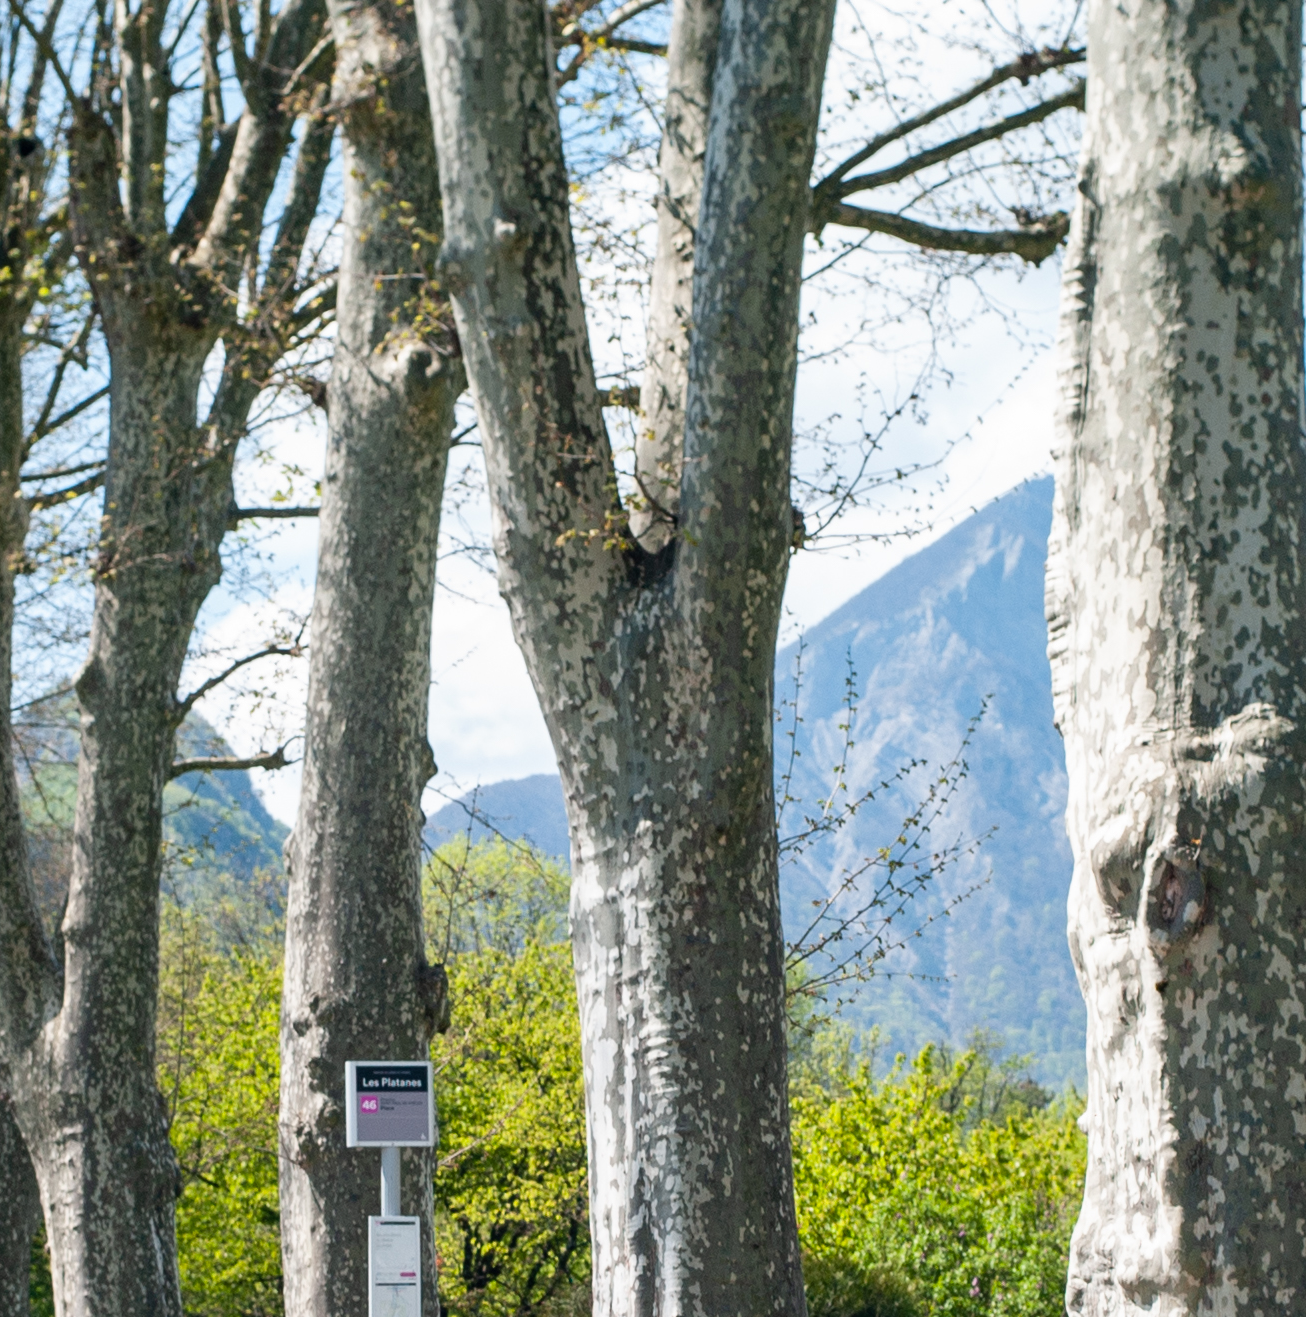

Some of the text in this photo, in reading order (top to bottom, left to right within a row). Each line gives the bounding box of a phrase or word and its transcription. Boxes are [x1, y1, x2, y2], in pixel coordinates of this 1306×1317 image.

[362, 1077, 422, 1088] Les Platanes
[362, 1099, 377, 1110] 46
